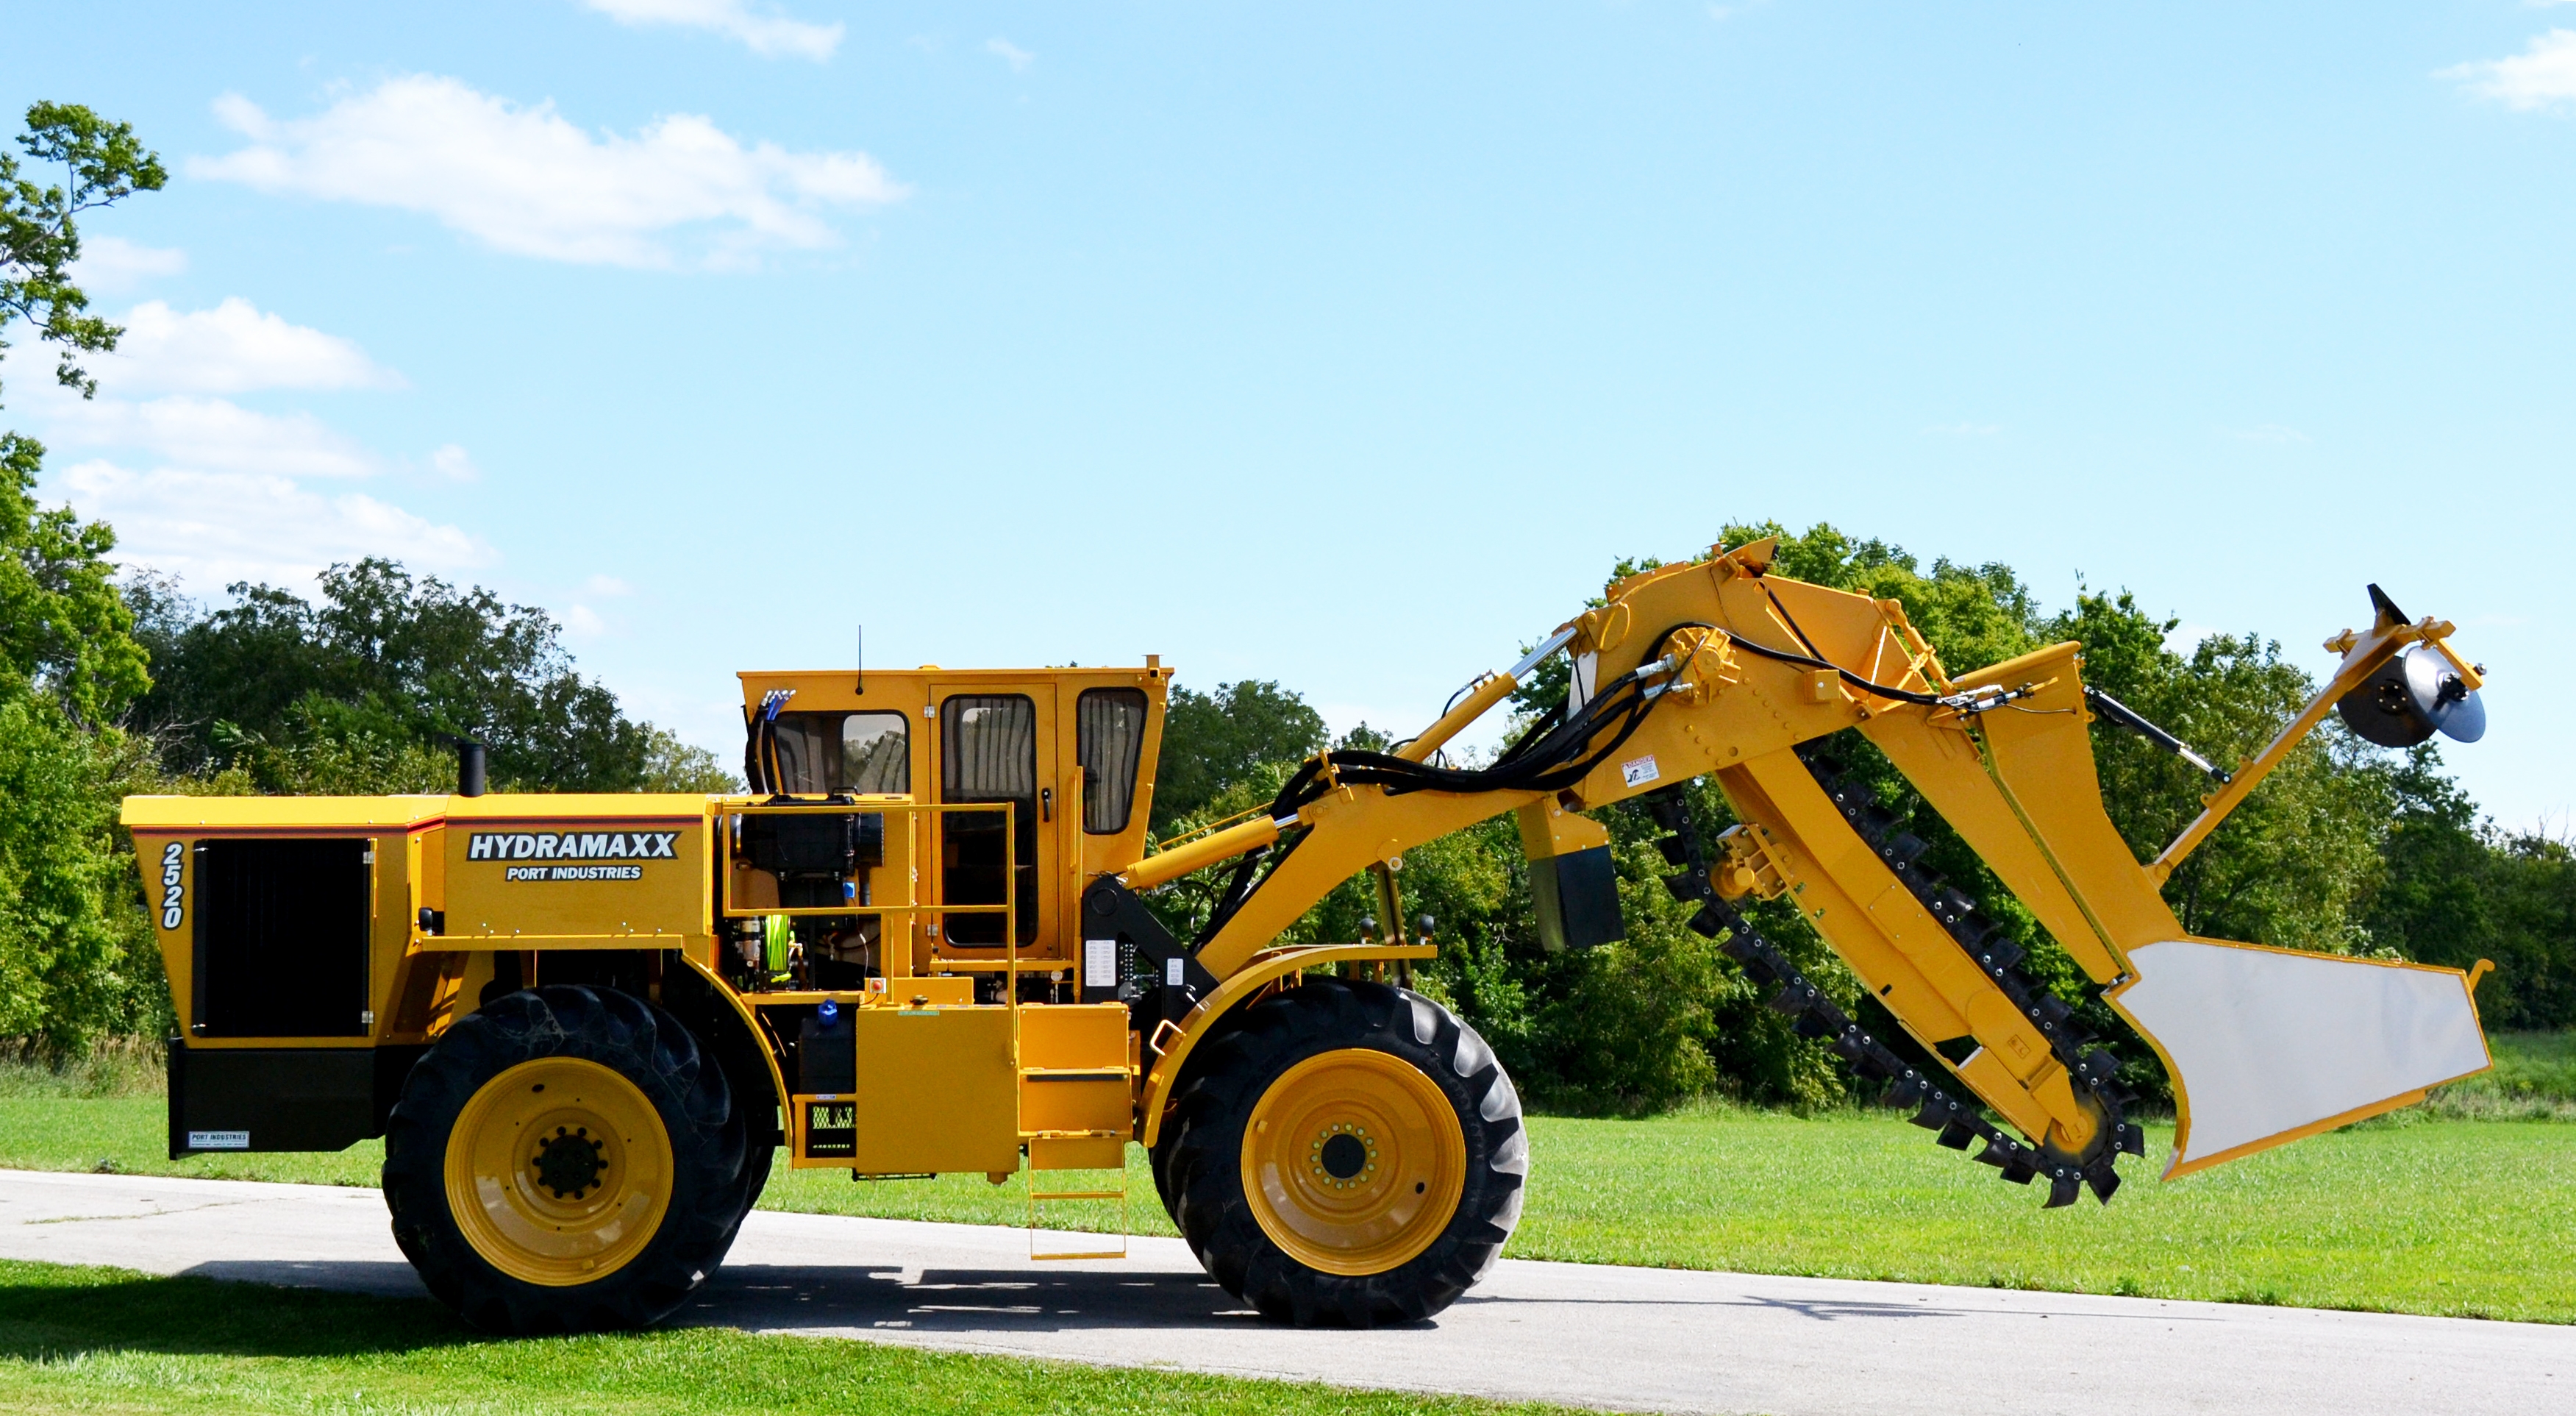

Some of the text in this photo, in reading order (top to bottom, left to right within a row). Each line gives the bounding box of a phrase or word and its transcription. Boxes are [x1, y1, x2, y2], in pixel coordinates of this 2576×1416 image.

[470, 833, 675, 858] HYDRAMAXX
[163, 844, 182, 928] 2520
[507, 867, 641, 880] PORT INDUSTRIES
